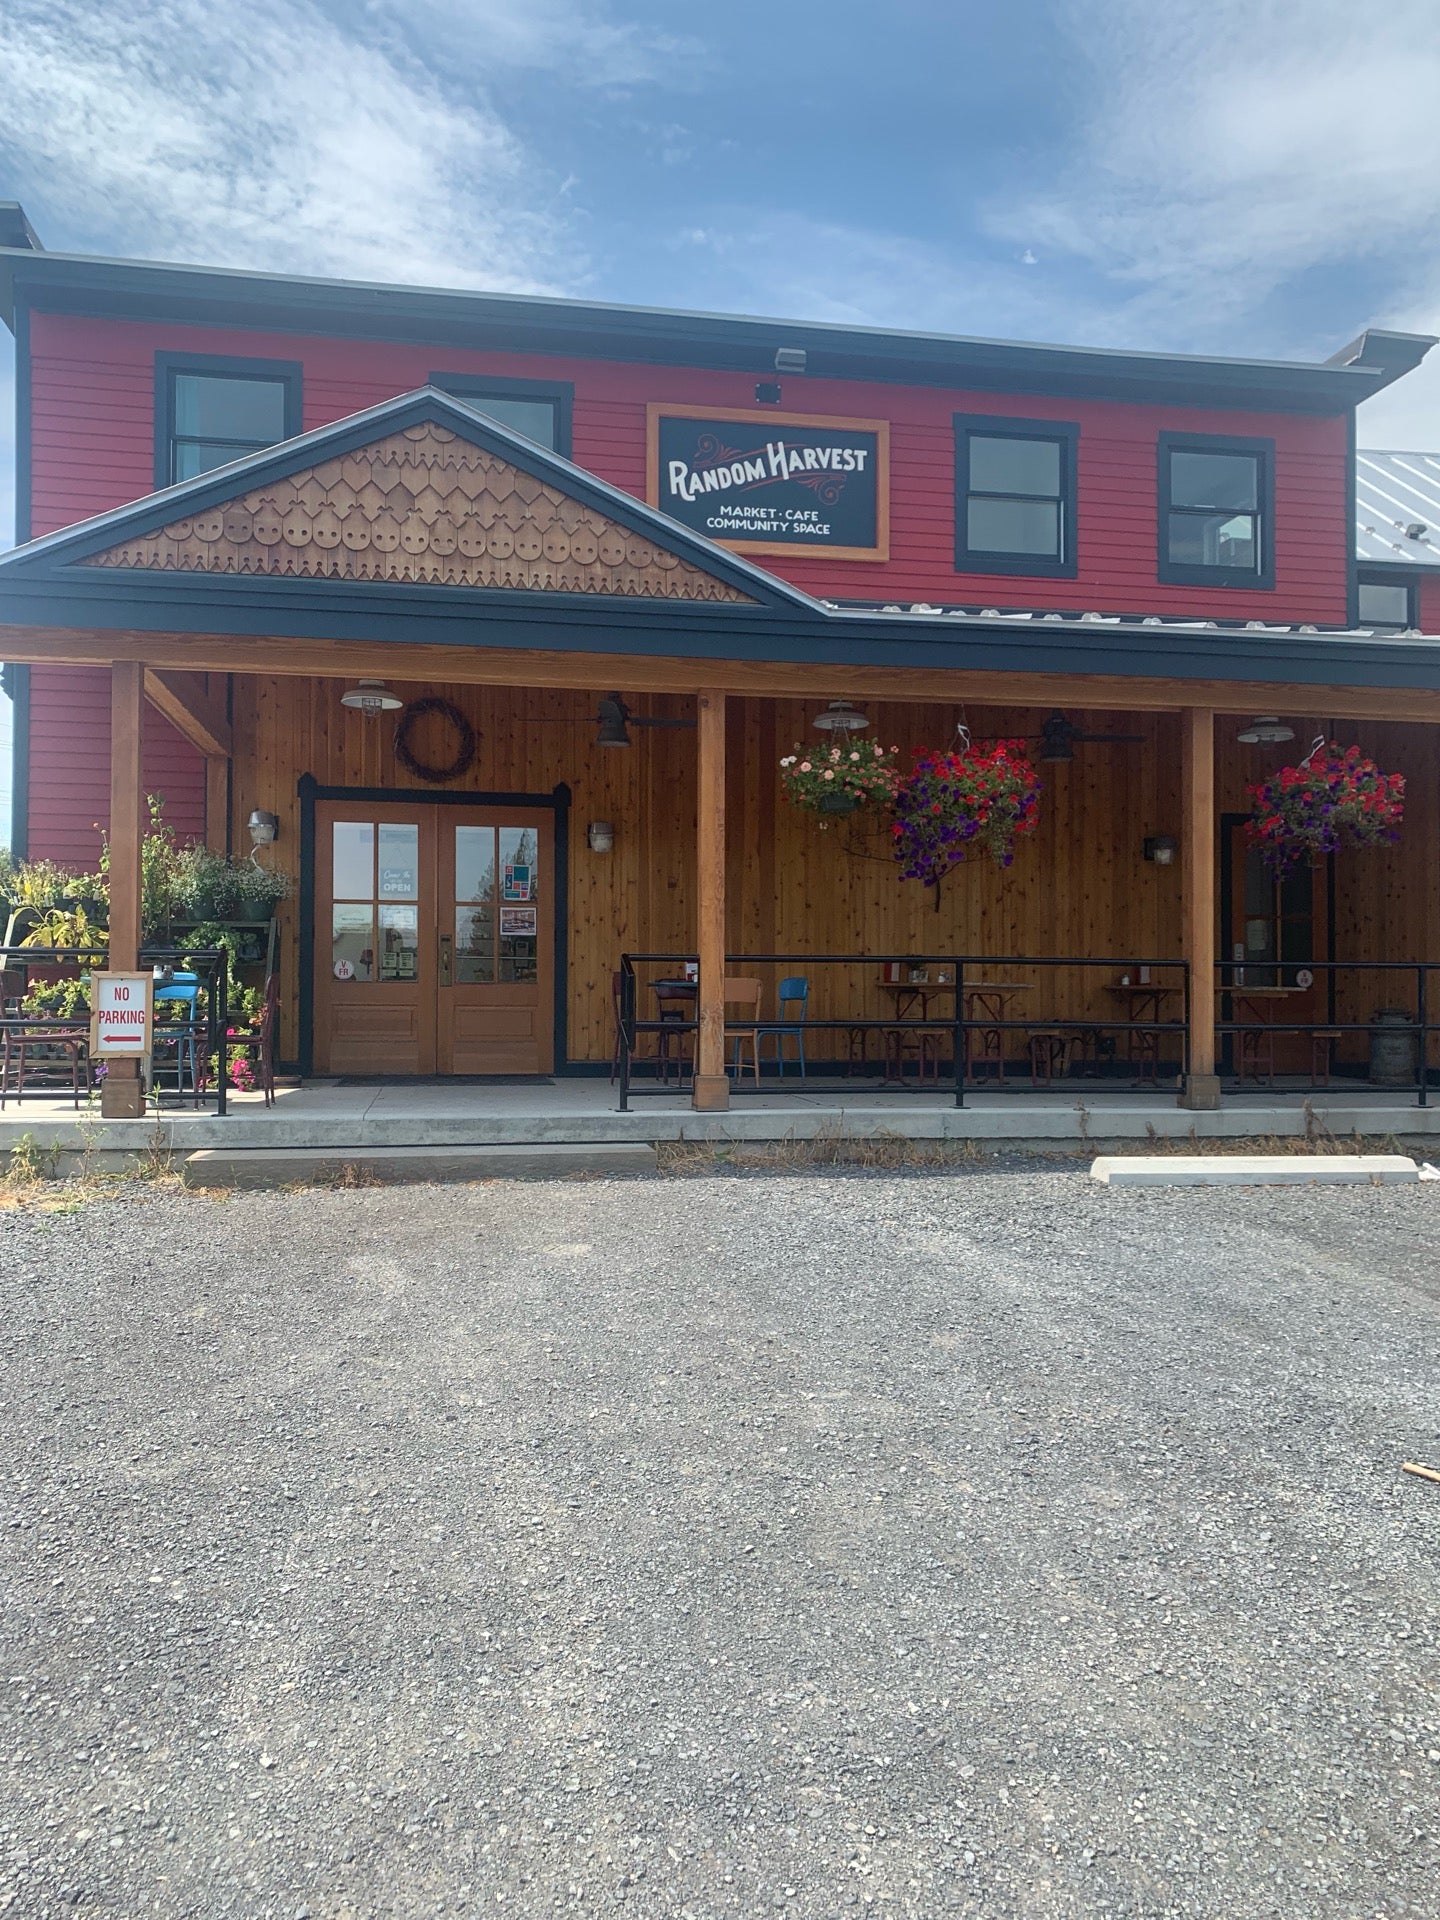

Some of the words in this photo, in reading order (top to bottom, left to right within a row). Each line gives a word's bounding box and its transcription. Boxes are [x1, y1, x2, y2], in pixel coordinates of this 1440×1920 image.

[668, 457, 767, 502] RANDOM
[766, 441, 867, 480] HARVEST
[720, 505, 776, 519] MARKET
[785, 509, 819, 521] CAFE
[706, 517, 789, 532] COMMUNITY
[793, 524, 831, 535] SPACE
[383, 883, 411, 892] OPEN
[114, 987, 130, 1001] NO
[98, 1010, 145, 1025] PARKING
